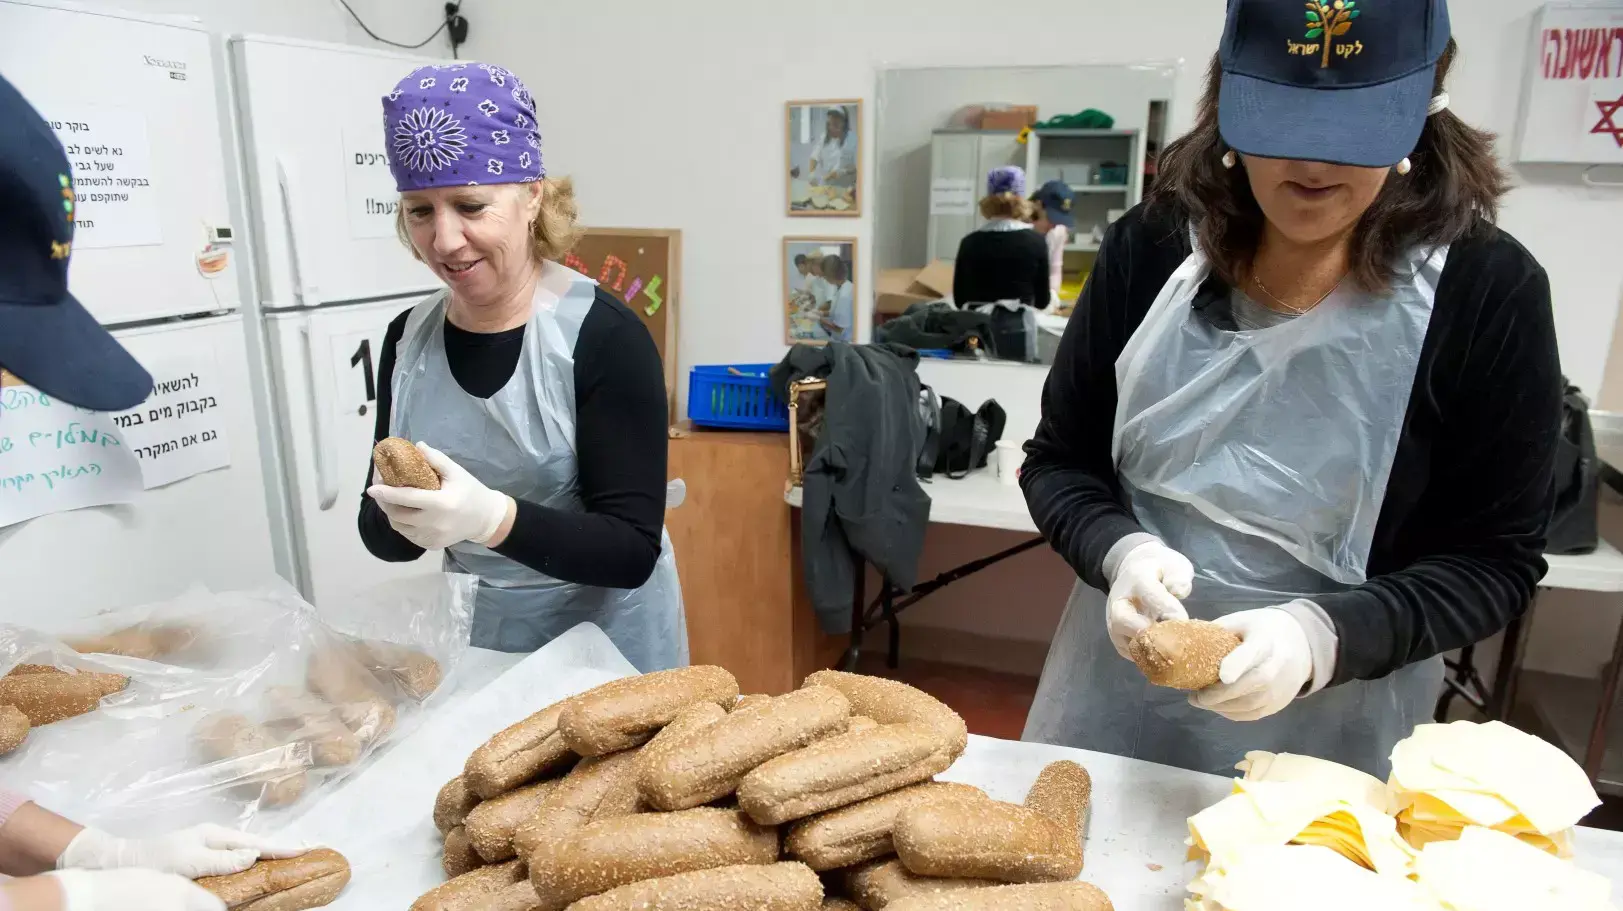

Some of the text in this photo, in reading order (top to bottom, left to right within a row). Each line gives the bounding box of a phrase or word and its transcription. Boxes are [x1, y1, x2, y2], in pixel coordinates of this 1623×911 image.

[1287, 39, 1363, 59] לקט ישראל
[65, 122, 90, 133] בוקר
[67, 144, 123, 156] נא לשים לב
[75, 160, 115, 171] שעל גבי
[355, 153, 390, 166] ריכים
[116, 178, 150, 189] בבקשה
[90, 193, 129, 204] שתוקפם
[72, 220, 95, 229] תוד
[176, 396, 218, 419] בקבוק
[149, 406, 173, 422] מים
[134, 430, 217, 460] גם אם המקרר
